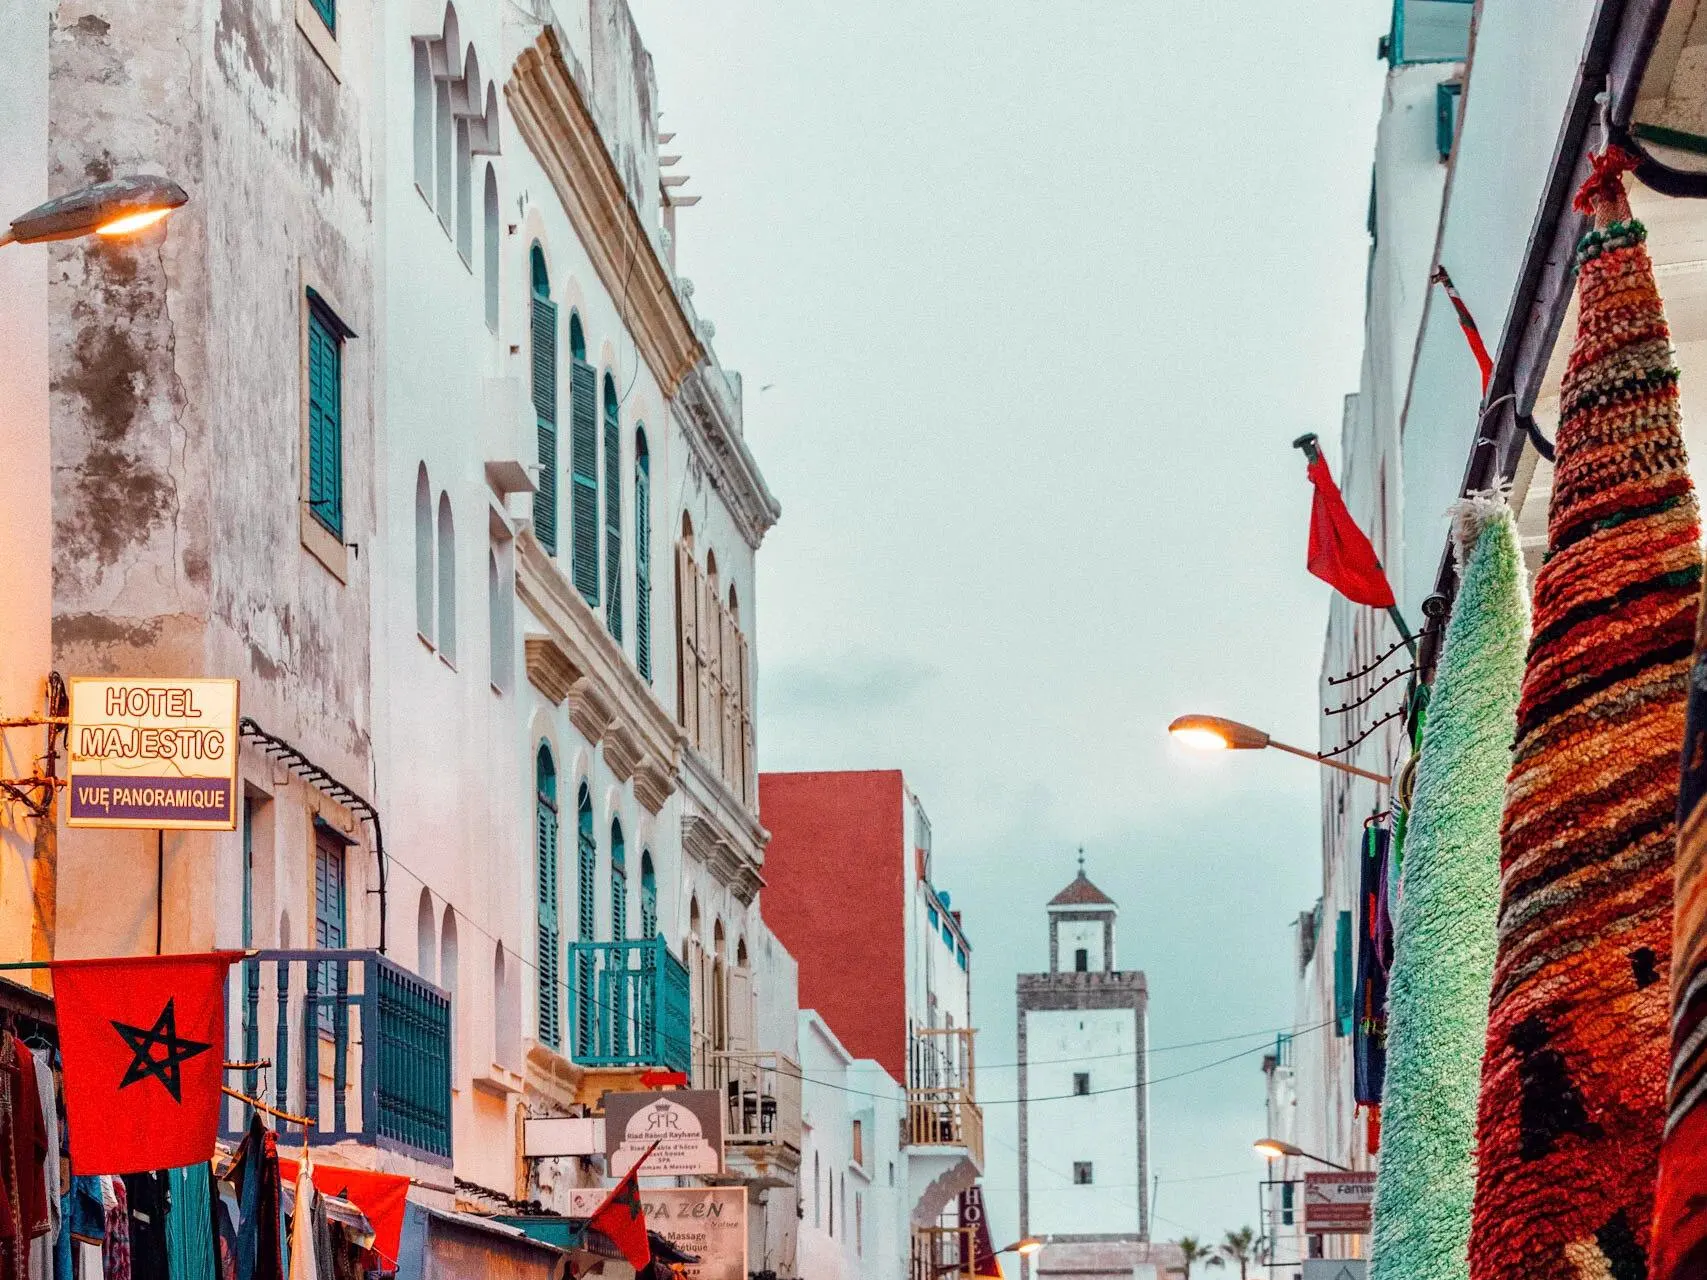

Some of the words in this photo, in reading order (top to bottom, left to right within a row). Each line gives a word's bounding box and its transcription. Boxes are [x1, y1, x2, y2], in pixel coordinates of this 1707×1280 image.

[106, 687, 201, 718] HOTEL
[80, 728, 225, 760] MAJESTIC
[78, 786, 109, 807] VUE
[112, 787, 225, 809] PANORAMIQUE
[642, 1202, 670, 1219] PA
[667, 1231, 706, 1242] Massage
